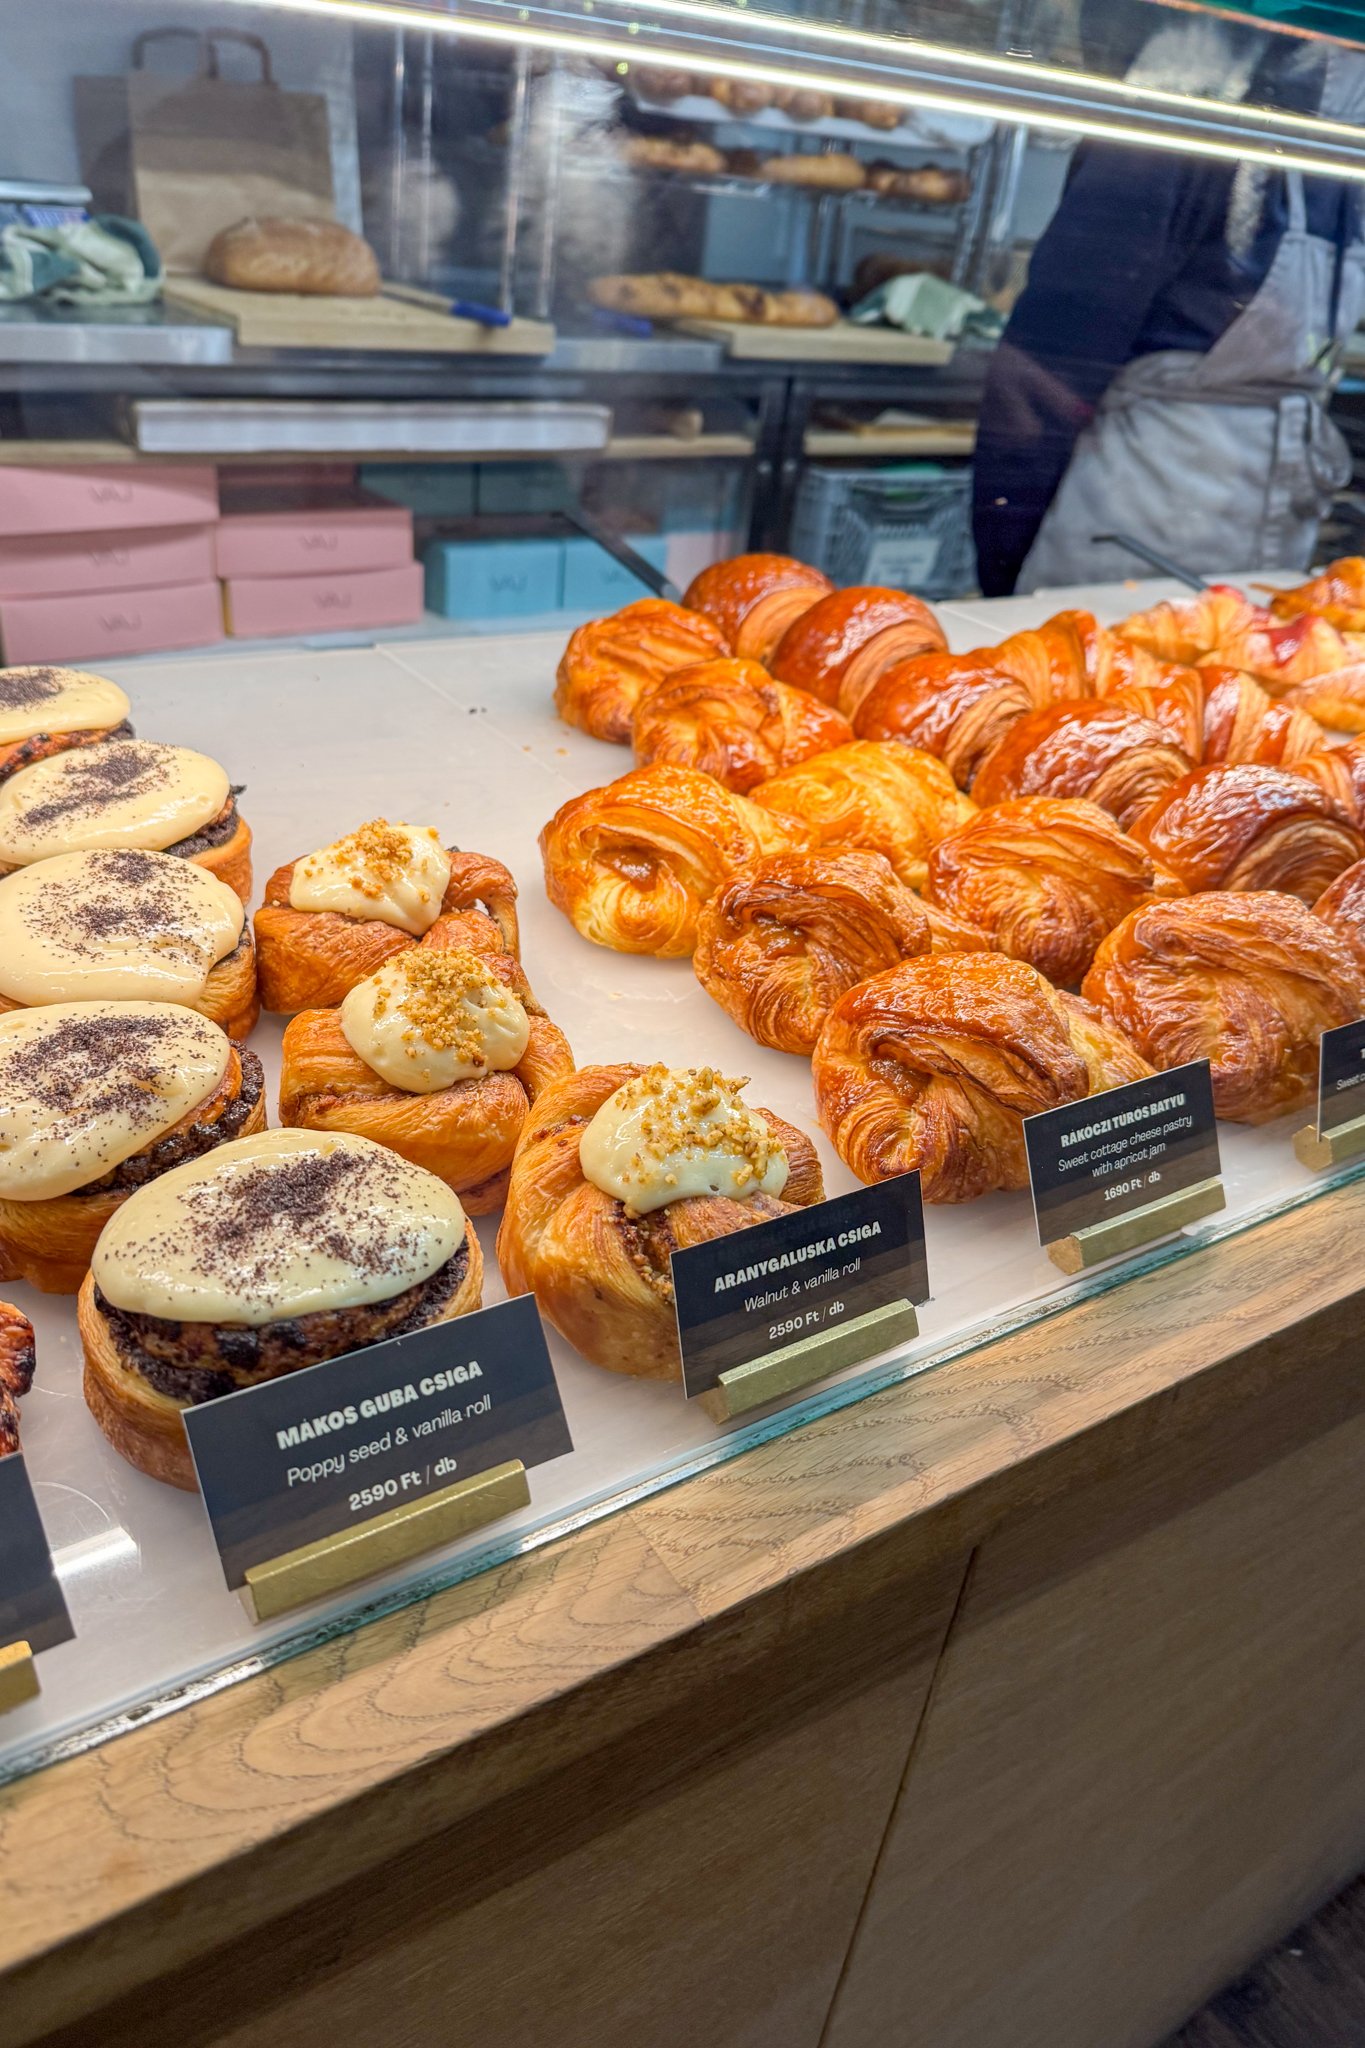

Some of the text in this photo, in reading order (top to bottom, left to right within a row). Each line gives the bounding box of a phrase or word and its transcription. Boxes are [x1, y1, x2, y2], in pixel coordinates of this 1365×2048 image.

[1150, 1093, 1186, 1116] BATYU
[1058, 1115, 1193, 1172] Sweet cottage cheese pastry
[1092, 1142, 1167, 1177] with apricot jam
[1104, 1170, 1161, 1201] 1690 Ft / db
[714, 1220, 882, 1293] ARANYGALUSKA CSIGA
[744, 1257, 861, 1312] Walnut & vanilla roll
[768, 1301, 845, 1340] 2590 Ft / db
[275, 1360, 484, 1451] MÁKOS GUBA CSIGA
[287, 1394, 492, 1487] Poppy seed & vanilla roll
[348, 1457, 458, 1512] 2590 Ft / db
